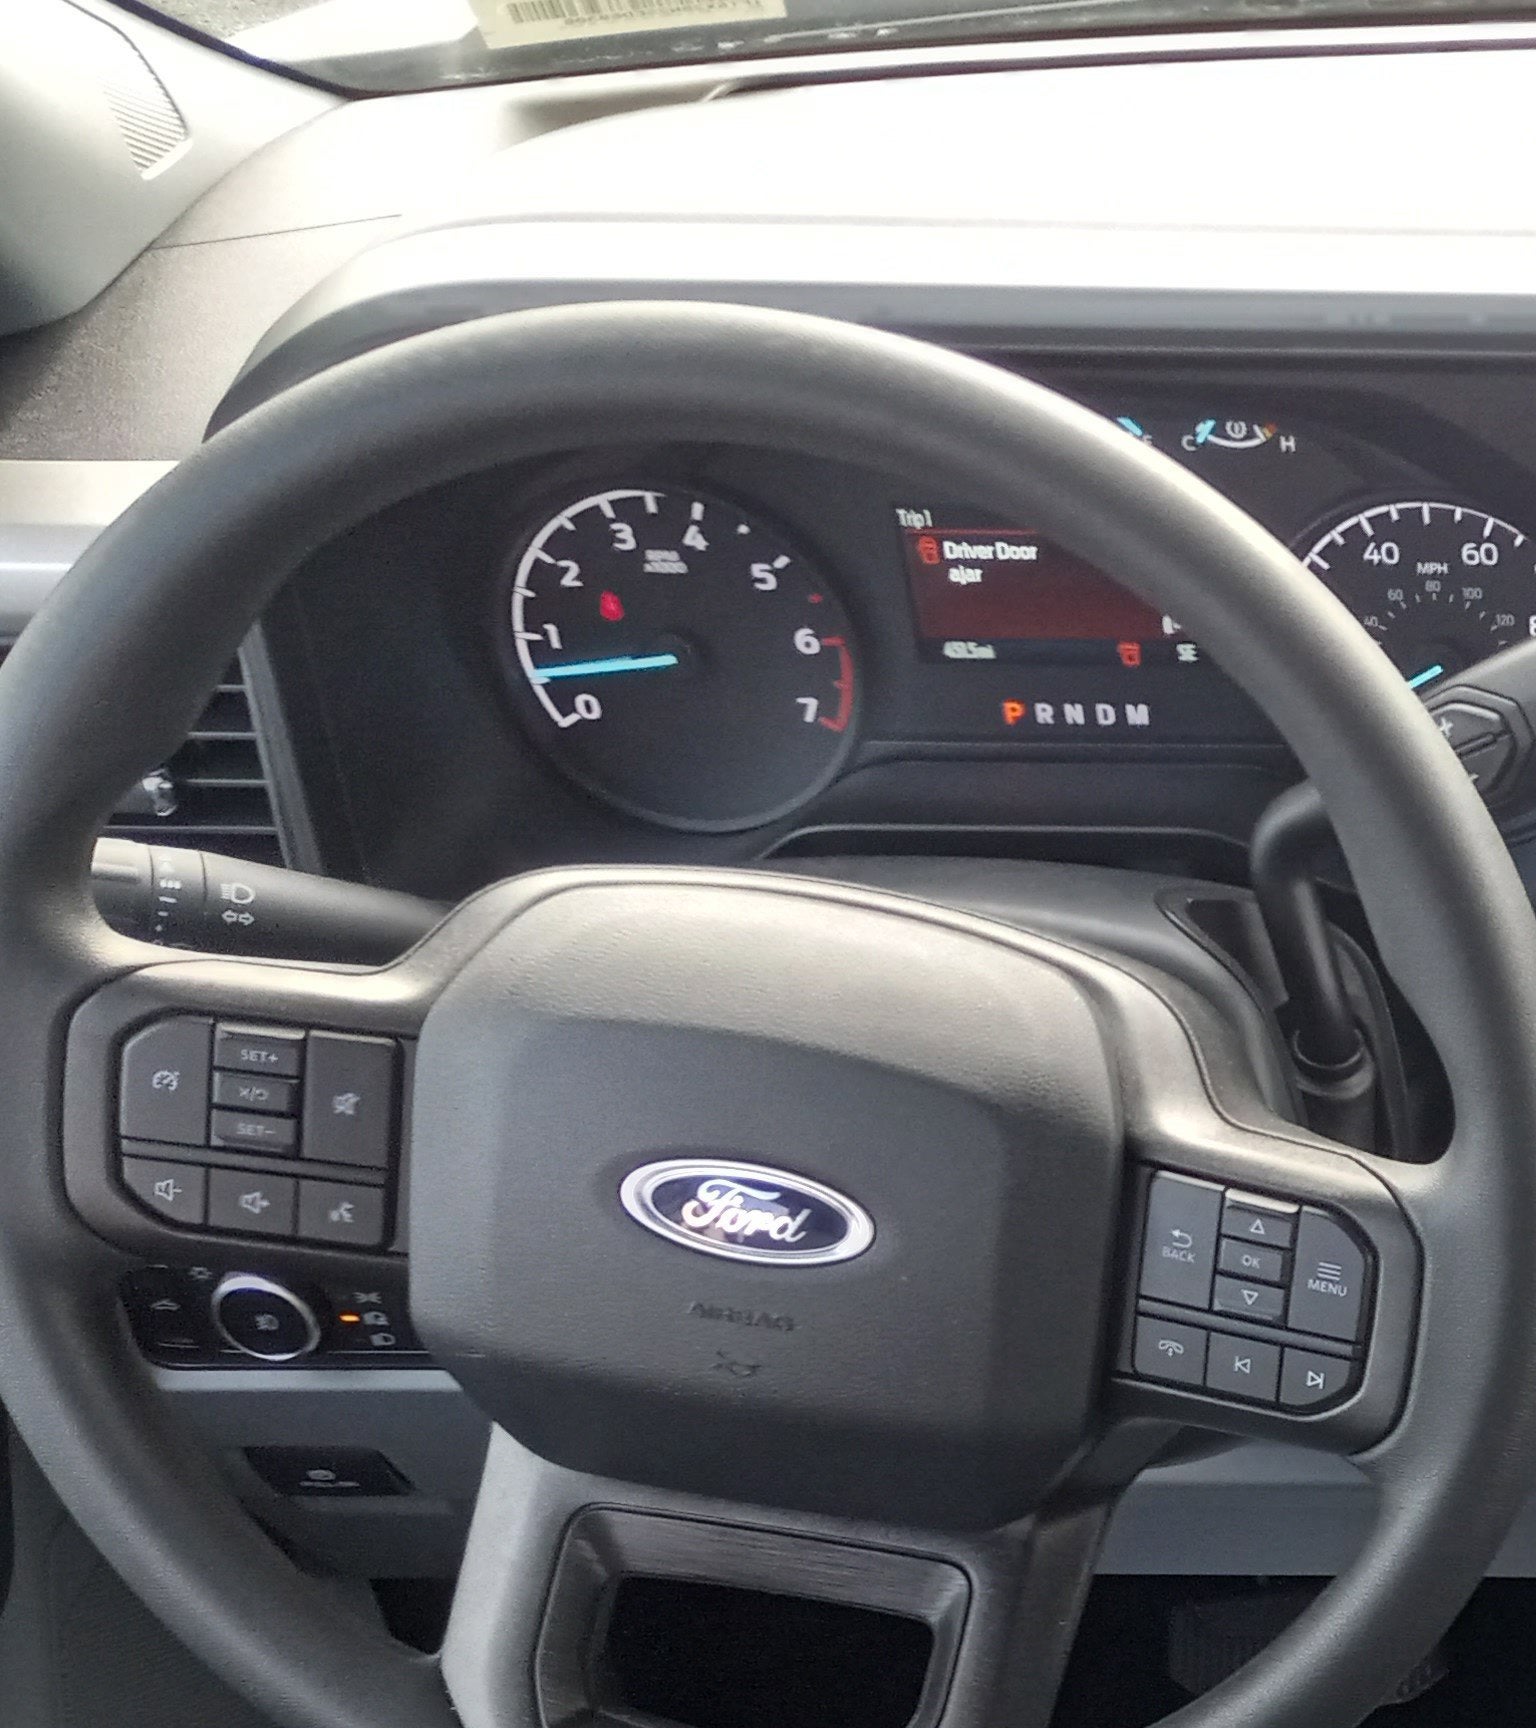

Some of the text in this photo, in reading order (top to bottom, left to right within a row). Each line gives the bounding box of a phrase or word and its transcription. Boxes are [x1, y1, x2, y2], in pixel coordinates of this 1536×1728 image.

[1181, 435, 1197, 451] C
[1279, 436, 1296, 452] H
[895, 508, 924, 529] Trip
[609, 523, 637, 550] 3
[682, 525, 709, 551] 4
[943, 541, 1038, 560] Driver Door
[1363, 542, 1400, 566] 40
[1461, 542, 1499, 566] 60
[555, 560, 583, 587] 2
[750, 564, 777, 591] 5
[948, 565, 983, 585] ajar
[1416, 562, 1449, 575] MPH
[543, 623, 563, 650] 1
[795, 628, 820, 655] 6
[574, 694, 602, 720] 0
[796, 697, 819, 722] 7
[1003, 698, 1150, 725] P R N D M
[681, 1179, 812, 1242] Ford
[1162, 1246, 1196, 1263] BACK
[1242, 1255, 1260, 1268] OK
[1307, 1278, 1347, 1297] MENU
